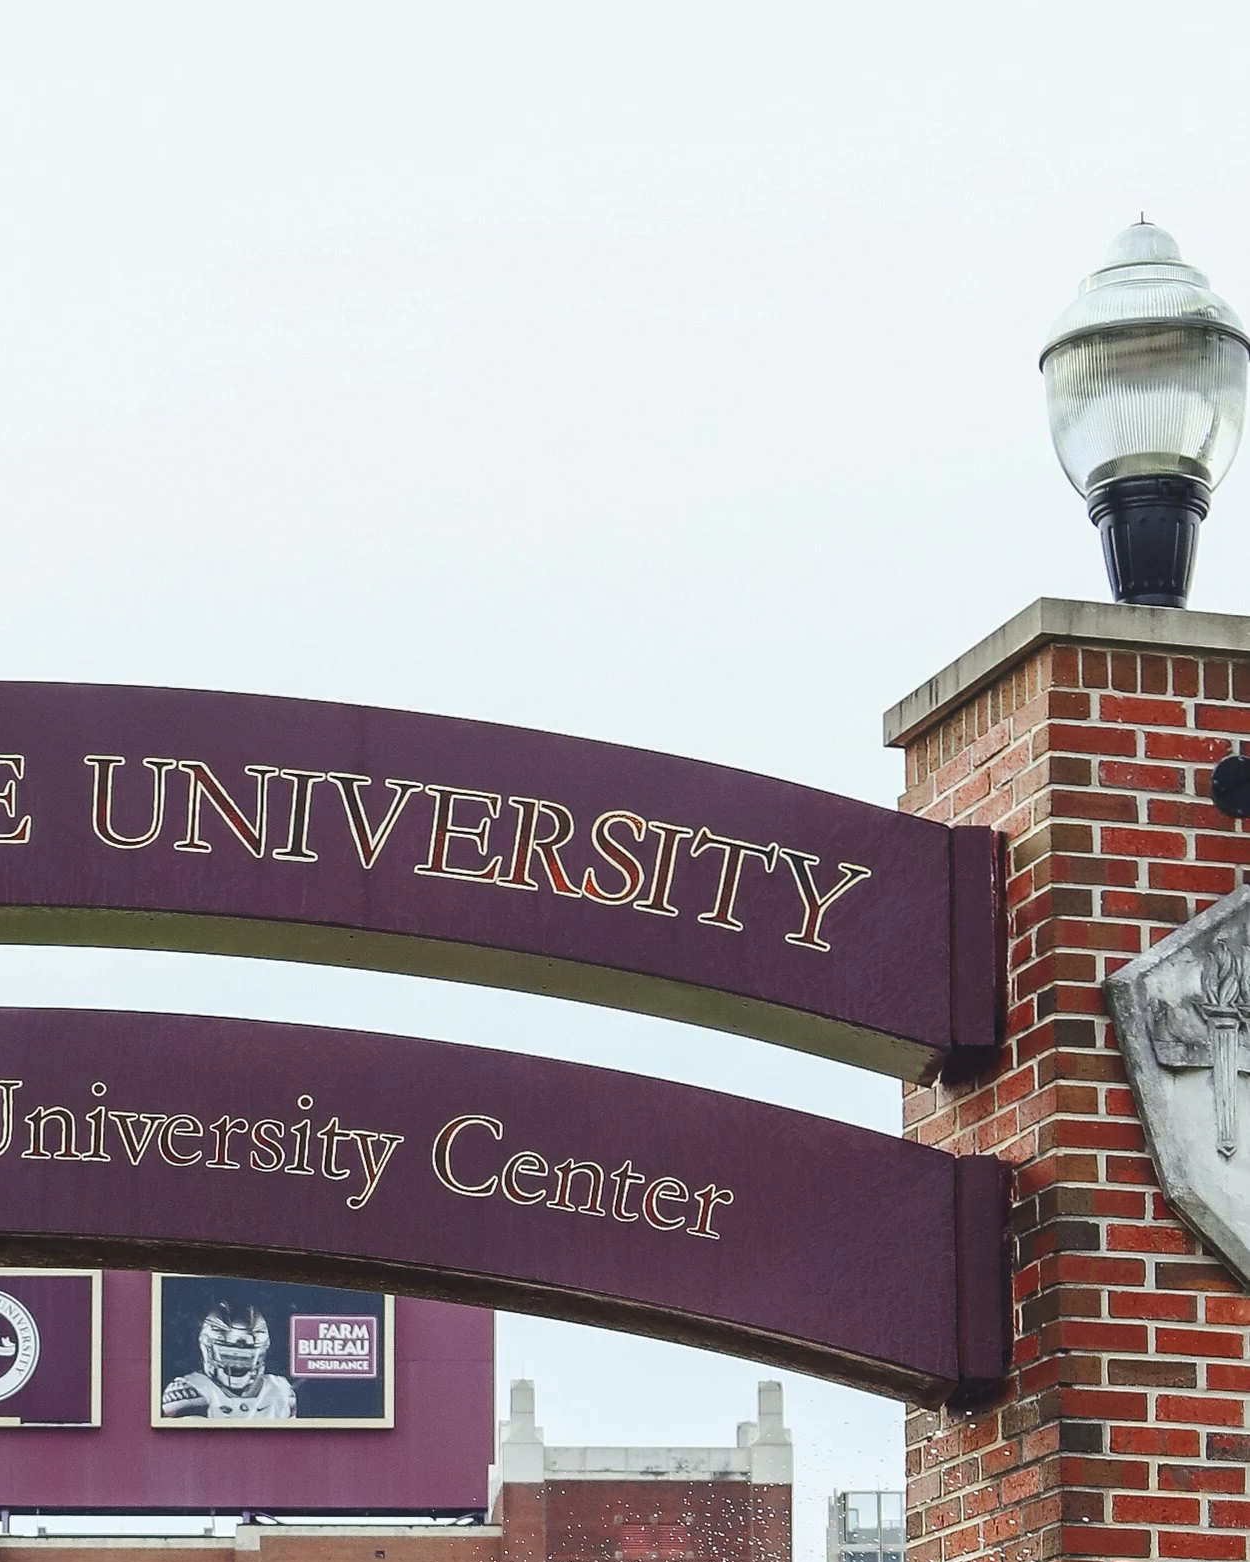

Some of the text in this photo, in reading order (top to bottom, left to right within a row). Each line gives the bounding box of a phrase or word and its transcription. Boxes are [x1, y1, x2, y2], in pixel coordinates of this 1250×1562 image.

[83, 754, 873, 953] UNIVERSITY
[432, 1114, 735, 1241] Center
[318, 1323, 370, 1339] FARM
[298, 1339, 370, 1355] BUREAU
[307, 1360, 370, 1371] INSURANCE
